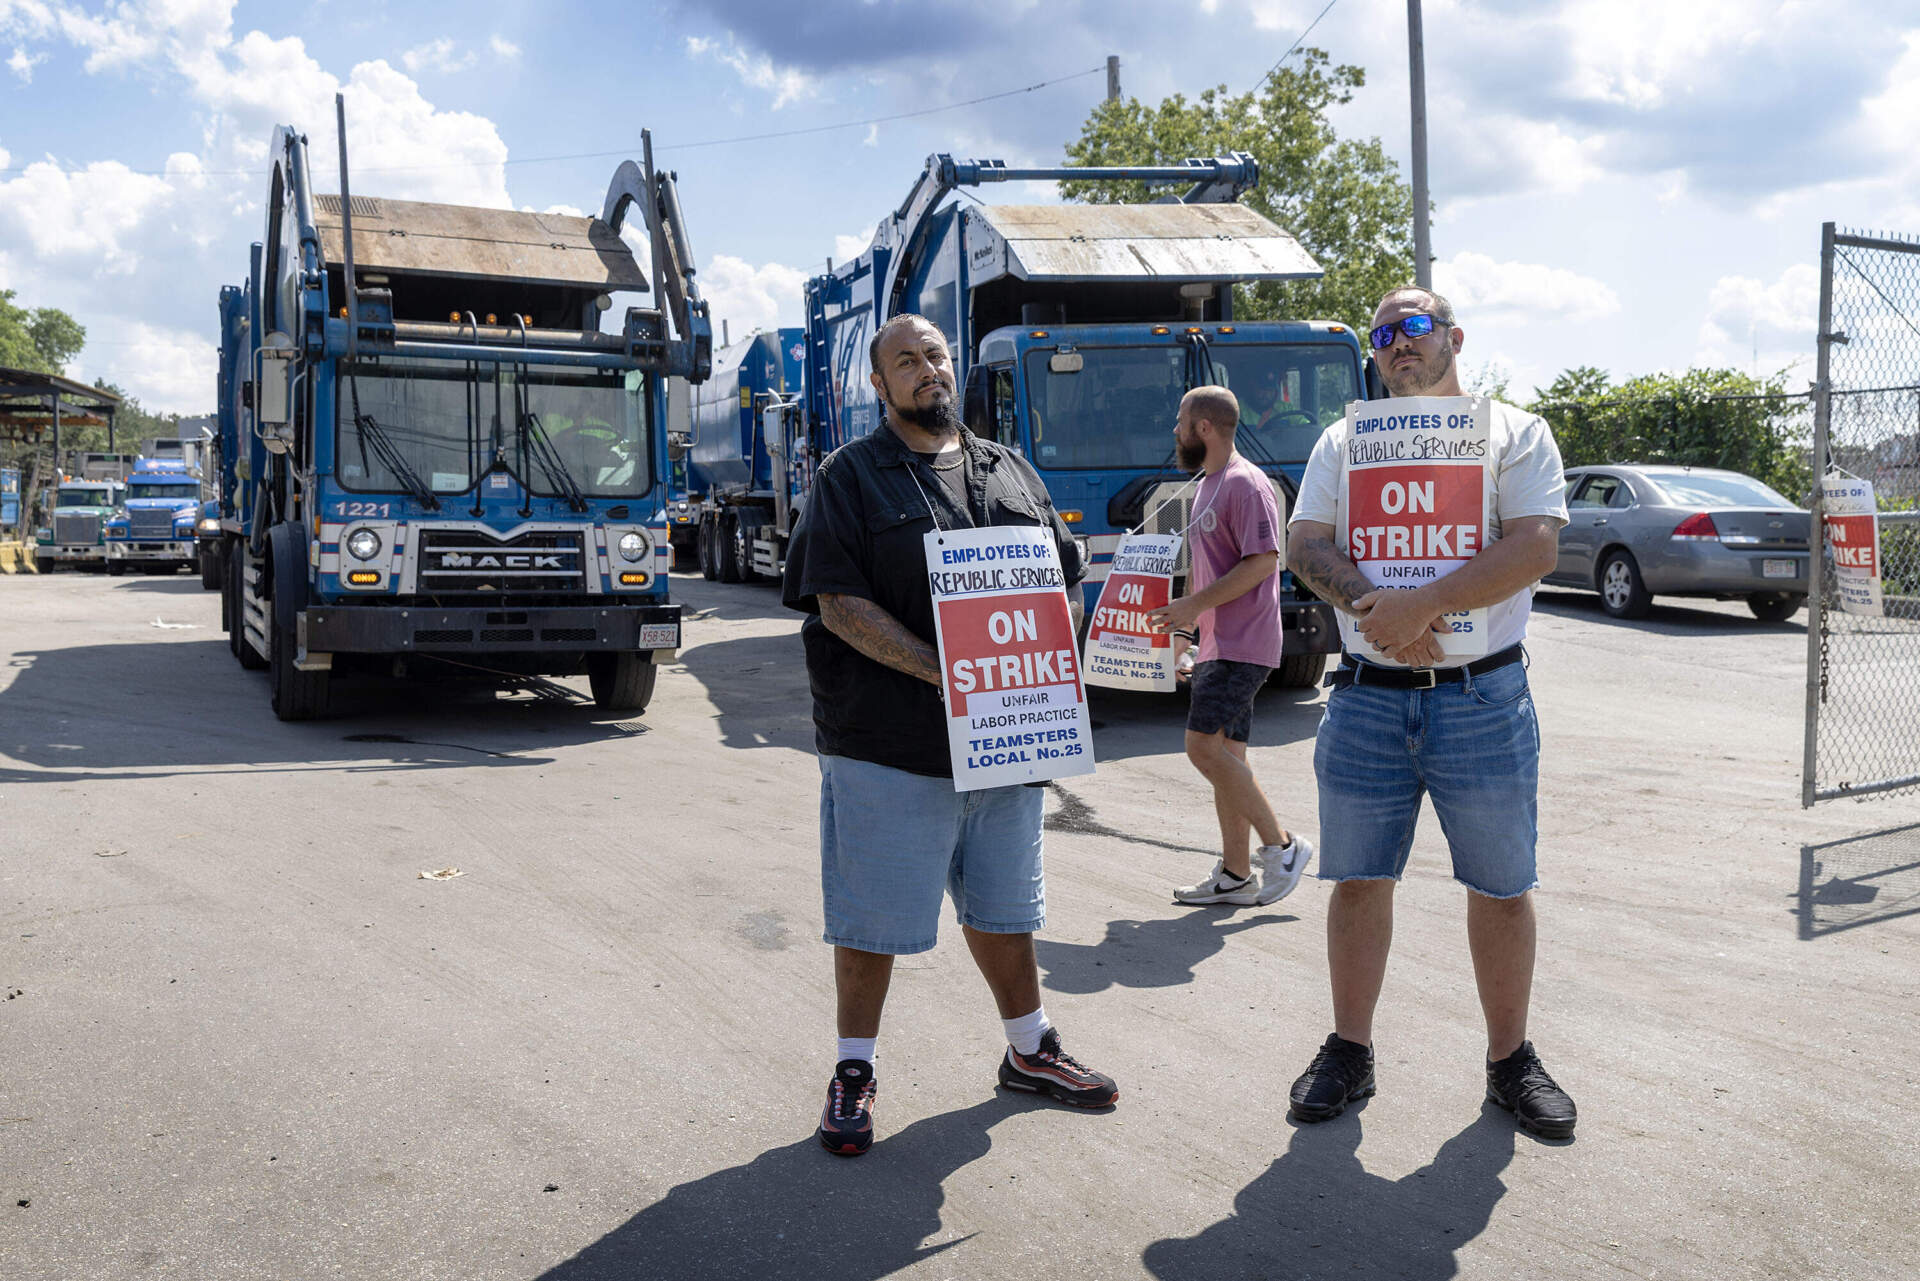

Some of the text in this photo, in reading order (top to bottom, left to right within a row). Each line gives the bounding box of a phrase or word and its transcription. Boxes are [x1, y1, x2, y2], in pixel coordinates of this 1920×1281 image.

[1356, 414, 1474, 435] EMPLOYEES OF:
[1349, 434, 1487, 464] REPUBLIC SERVICES
[1380, 481, 1435, 515] ON
[336, 502, 390, 518] 1221
[1123, 545, 1157, 554] EMPLOYEES
[1351, 525, 1478, 560] STRIKE
[441, 555, 563, 568] MACK
[942, 544, 1051, 565] EMPLOYEES OF:
[930, 567, 1065, 595] REPUBLIC SERVICES
[1382, 566, 1436, 578] UNFAIR
[1119, 583, 1145, 605] ON
[988, 609, 1038, 645] ON
[1100, 641, 1150, 655] LABOR PRACTICE
[1113, 635, 1135, 644] UNFAIR
[952, 649, 1076, 693] STRIKE
[1091, 665, 1127, 677] LOCAL
[1093, 655, 1163, 670] TEAMSTERS
[1002, 693, 1050, 708] UNFAIR
[972, 708, 1078, 730] LABOR PRACTICE
[969, 727, 1078, 752] TEAMSTERS
[968, 750, 1031, 769] LOCAL
